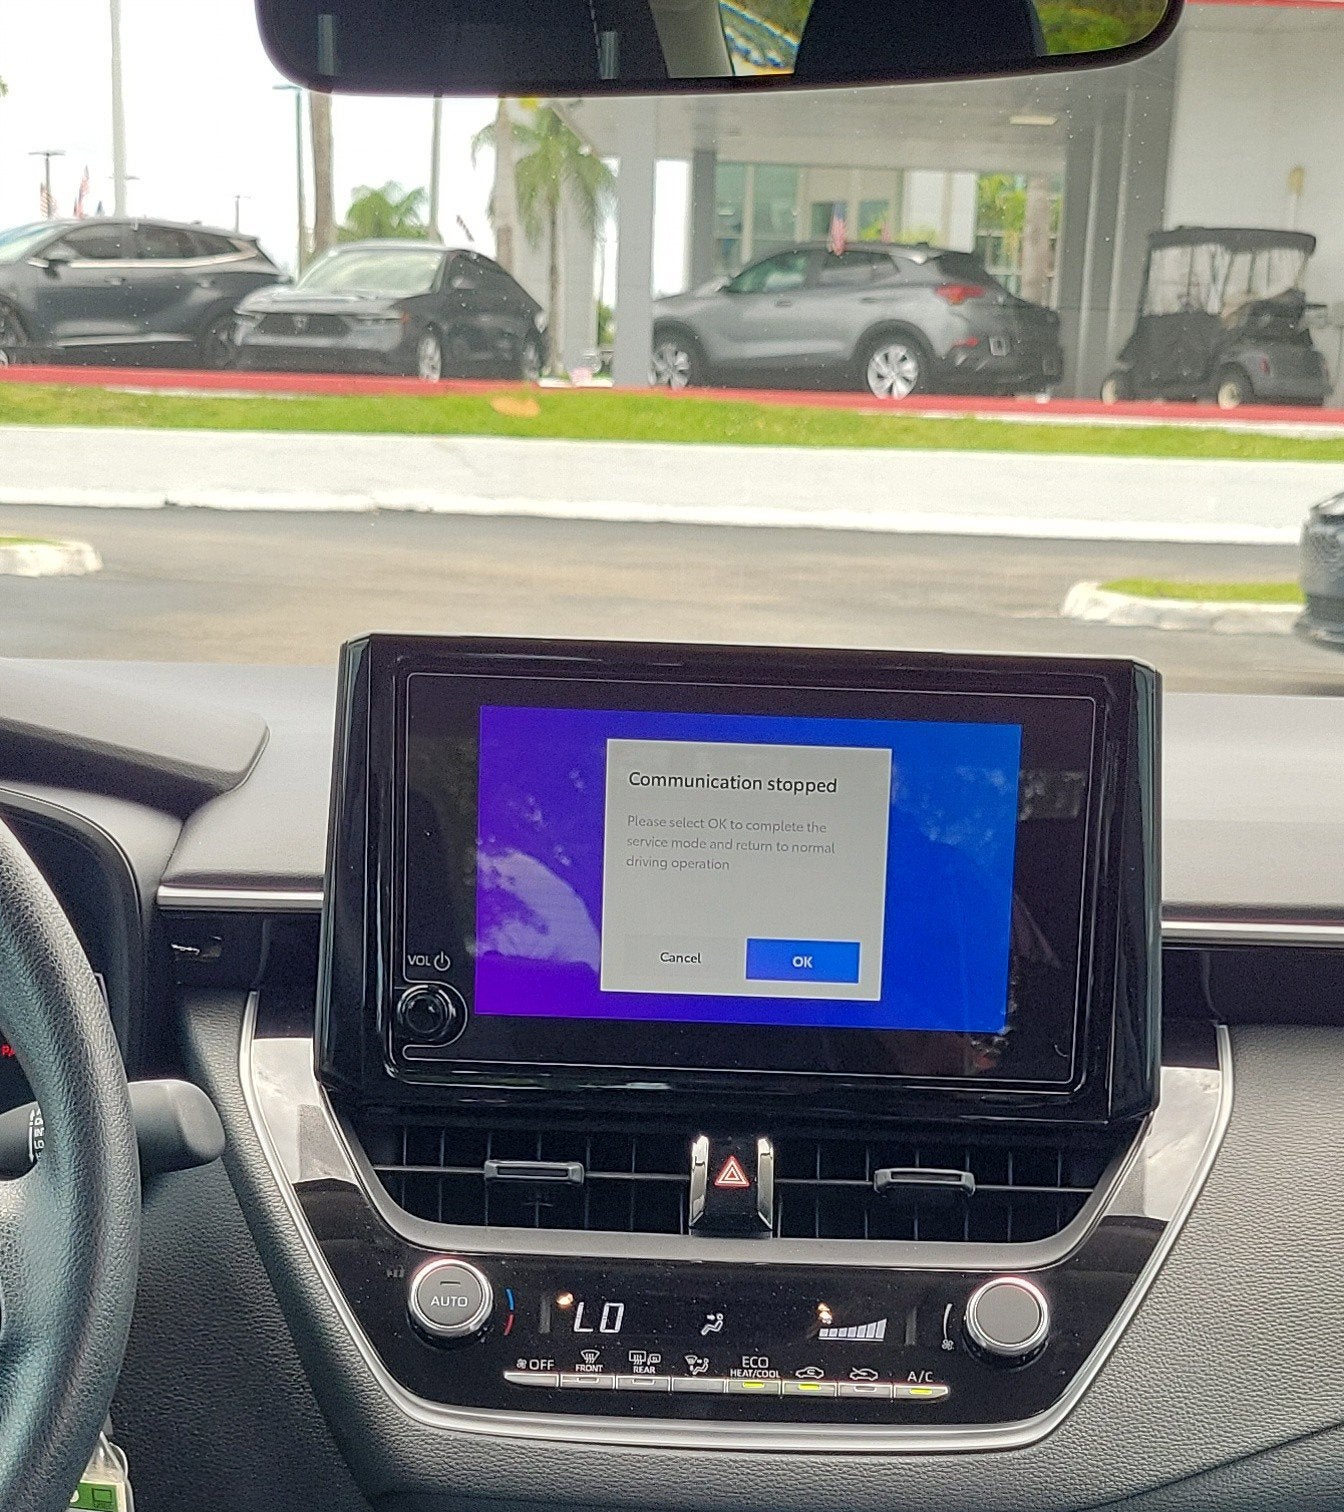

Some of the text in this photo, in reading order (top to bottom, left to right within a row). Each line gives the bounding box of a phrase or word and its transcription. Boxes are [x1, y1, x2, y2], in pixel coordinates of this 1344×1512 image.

[628, 771, 838, 796] Communication stopped
[627, 815, 827, 834] Please select OK to complete the
[626, 836, 835, 854] service mode and return to normal
[626, 855, 730, 871] driving operation
[407, 954, 431, 966] VOL
[660, 951, 814, 968] Cancel OK
[430, 1296, 468, 1307] AUTO
[573, 1301, 625, 1333] LO
[528, 1358, 555, 1371] OFF
[575, 1363, 604, 1373] FRONT
[742, 1356, 769, 1369] ECO
[633, 1365, 656, 1375] REAR
[729, 1368, 781, 1379] HEAT/COOL
[907, 1370, 934, 1384] A/C
